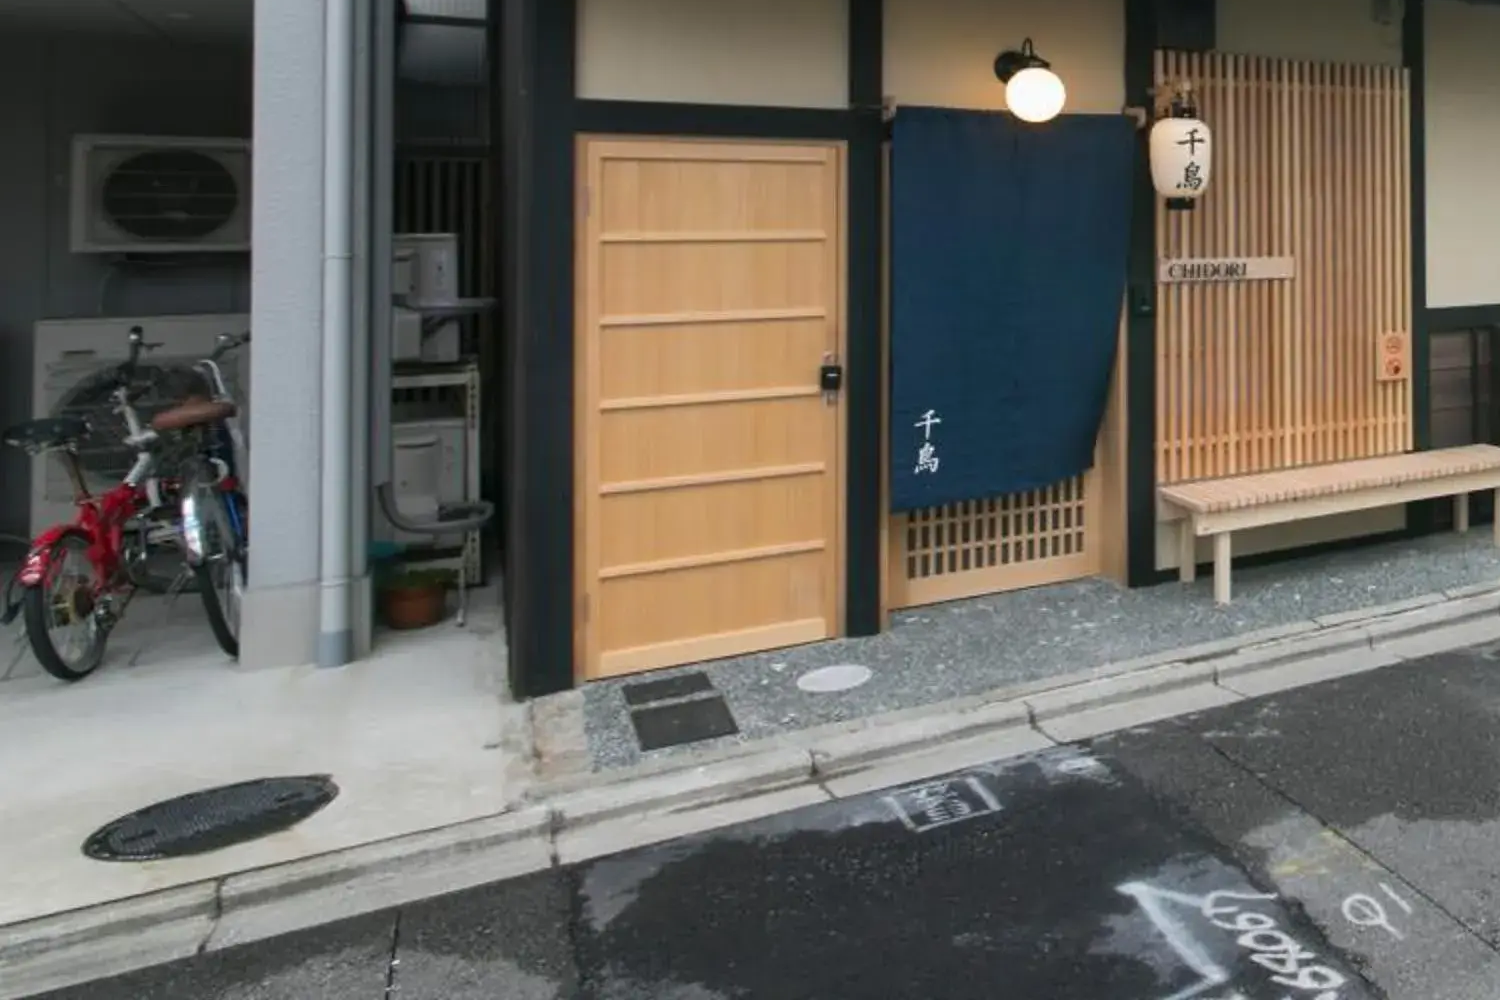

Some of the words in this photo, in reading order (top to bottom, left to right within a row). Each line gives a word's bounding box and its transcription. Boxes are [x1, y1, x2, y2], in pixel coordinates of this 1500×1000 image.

[1176, 128, 1205, 190] 千鳥
[1168, 263, 1248, 279] CHIDORI
[913, 409, 941, 474] 千鳥
